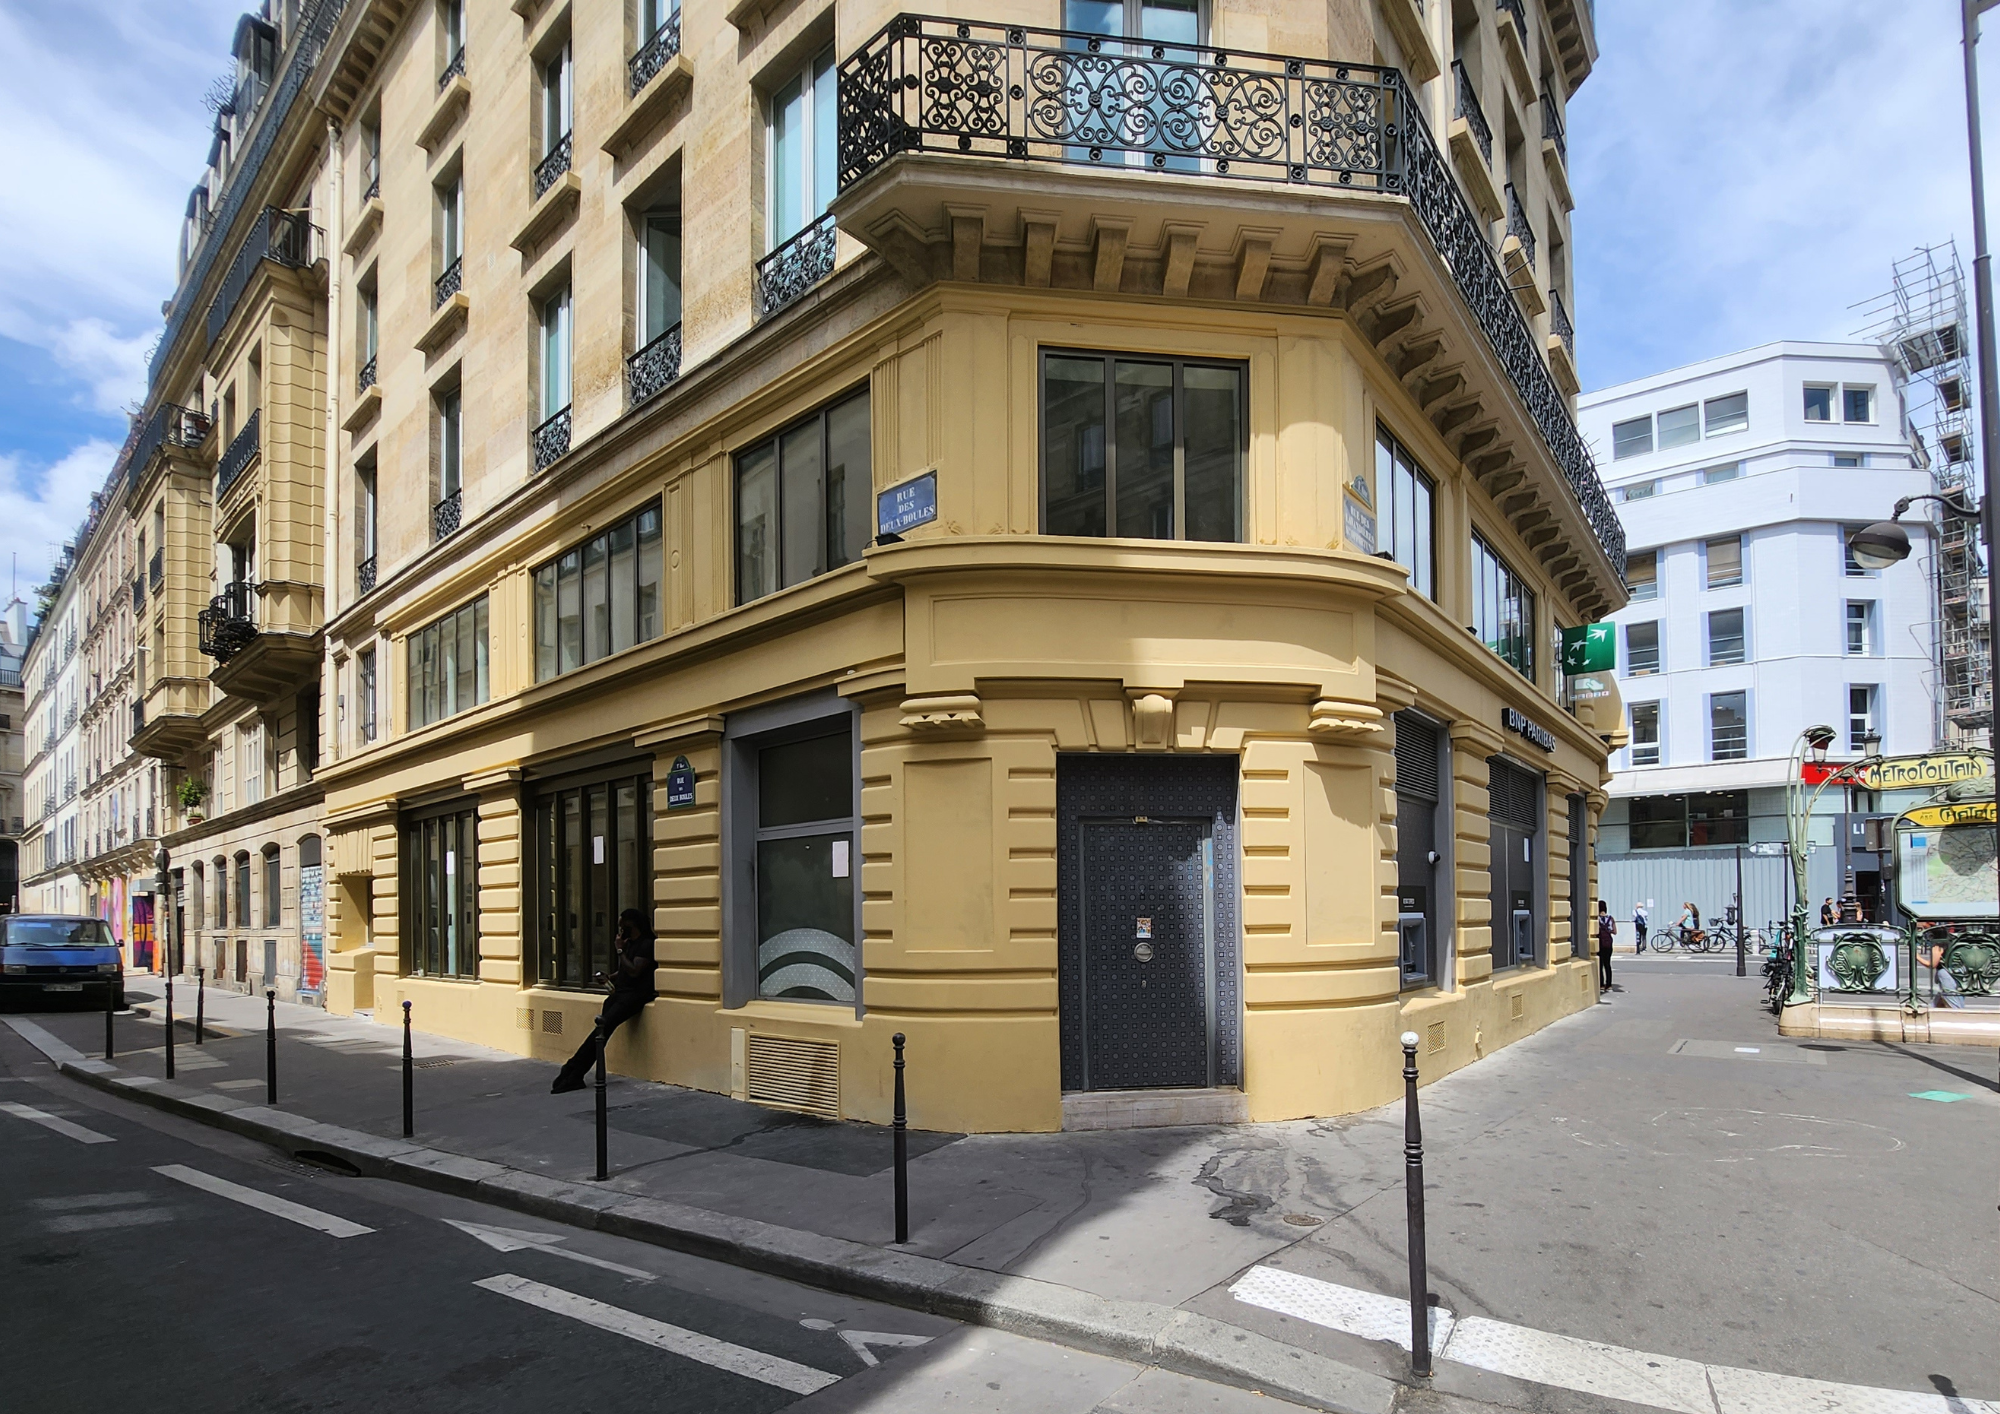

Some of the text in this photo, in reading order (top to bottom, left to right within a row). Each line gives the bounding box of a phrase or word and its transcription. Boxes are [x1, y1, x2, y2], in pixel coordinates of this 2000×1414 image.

[896, 486, 916, 503] RUE
[898, 500, 915, 514] DES
[1509, 707, 1557, 753] BNP PARIBAS
[1870, 759, 1983, 784] METROPOLITAIN
